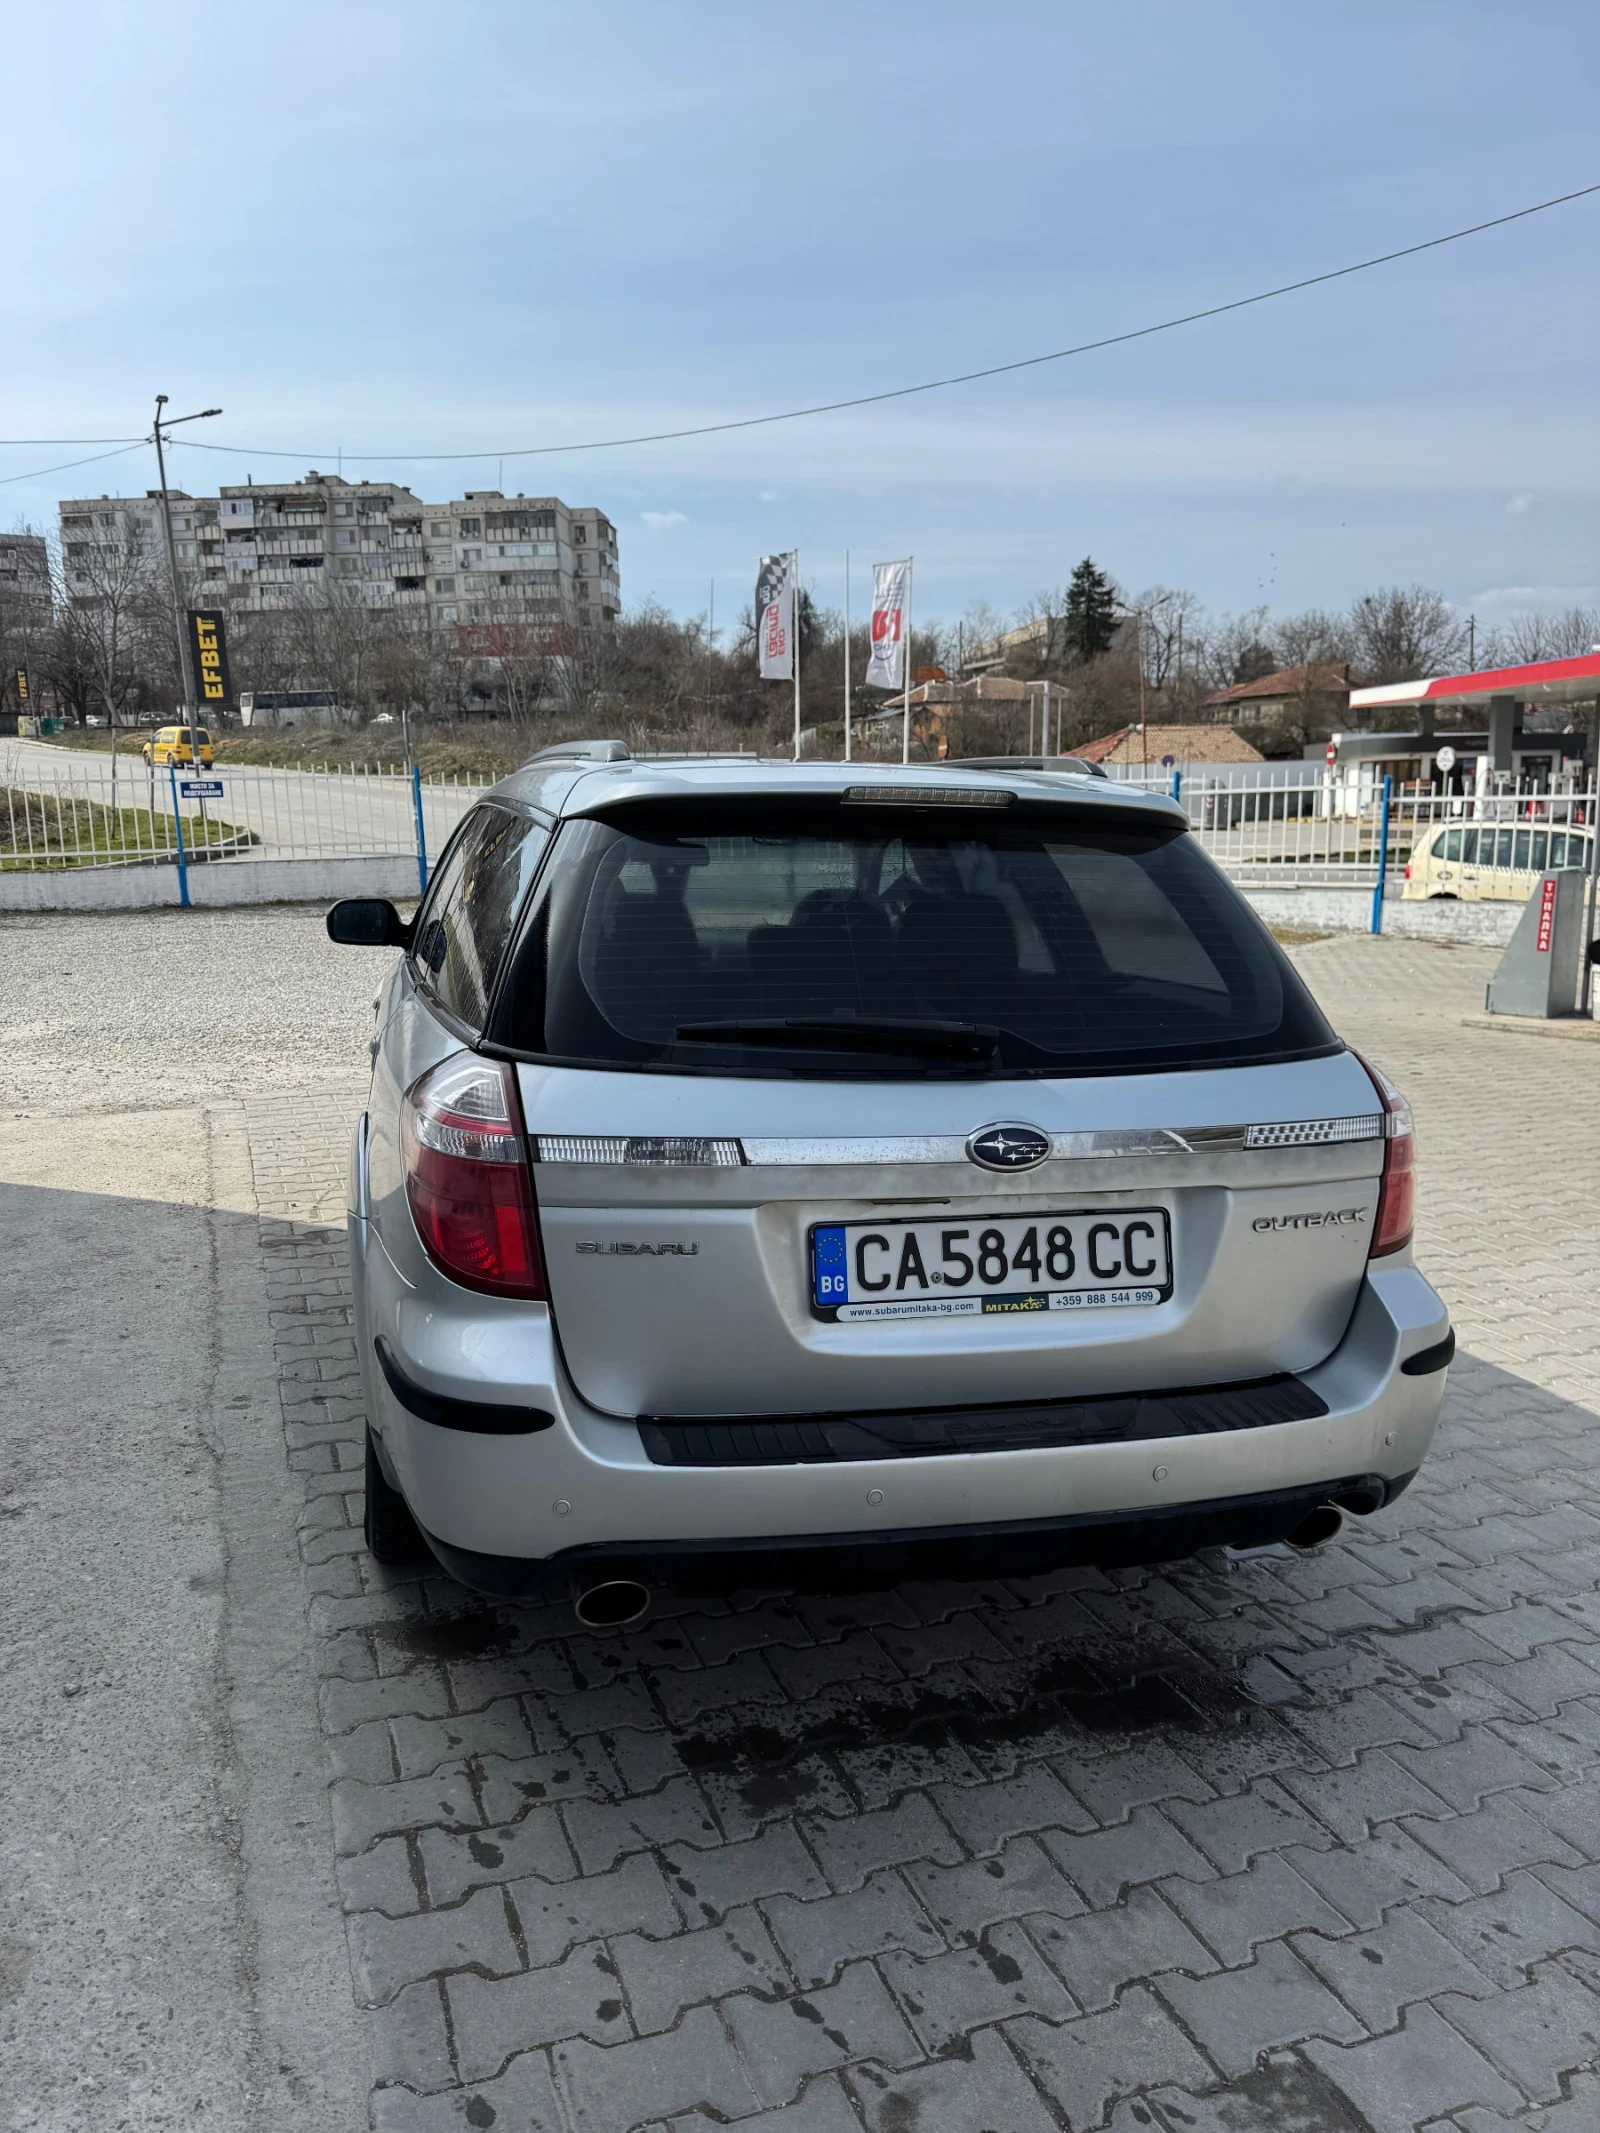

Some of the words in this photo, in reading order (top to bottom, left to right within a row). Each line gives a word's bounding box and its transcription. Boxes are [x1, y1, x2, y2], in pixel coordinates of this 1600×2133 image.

[196, 616, 224, 698] EFBET
[17, 670, 28, 698] EFBET
[1539, 882, 1554, 950] ТУПАЛКА
[1253, 1206, 1368, 1233] OUTBACK
[576, 1240, 699, 1256] SUBARU
[821, 1275, 845, 1293] BG
[850, 1303, 974, 1317] www.subarumitaka-bg.com
[985, 1301, 1040, 1312] MITAKA
[1055, 1295, 1082, 1306] +359
[1087, 1293, 1106, 1304] 888
[1111, 1292, 1130, 1303] 544
[1135, 1291, 1154, 1302] 999
